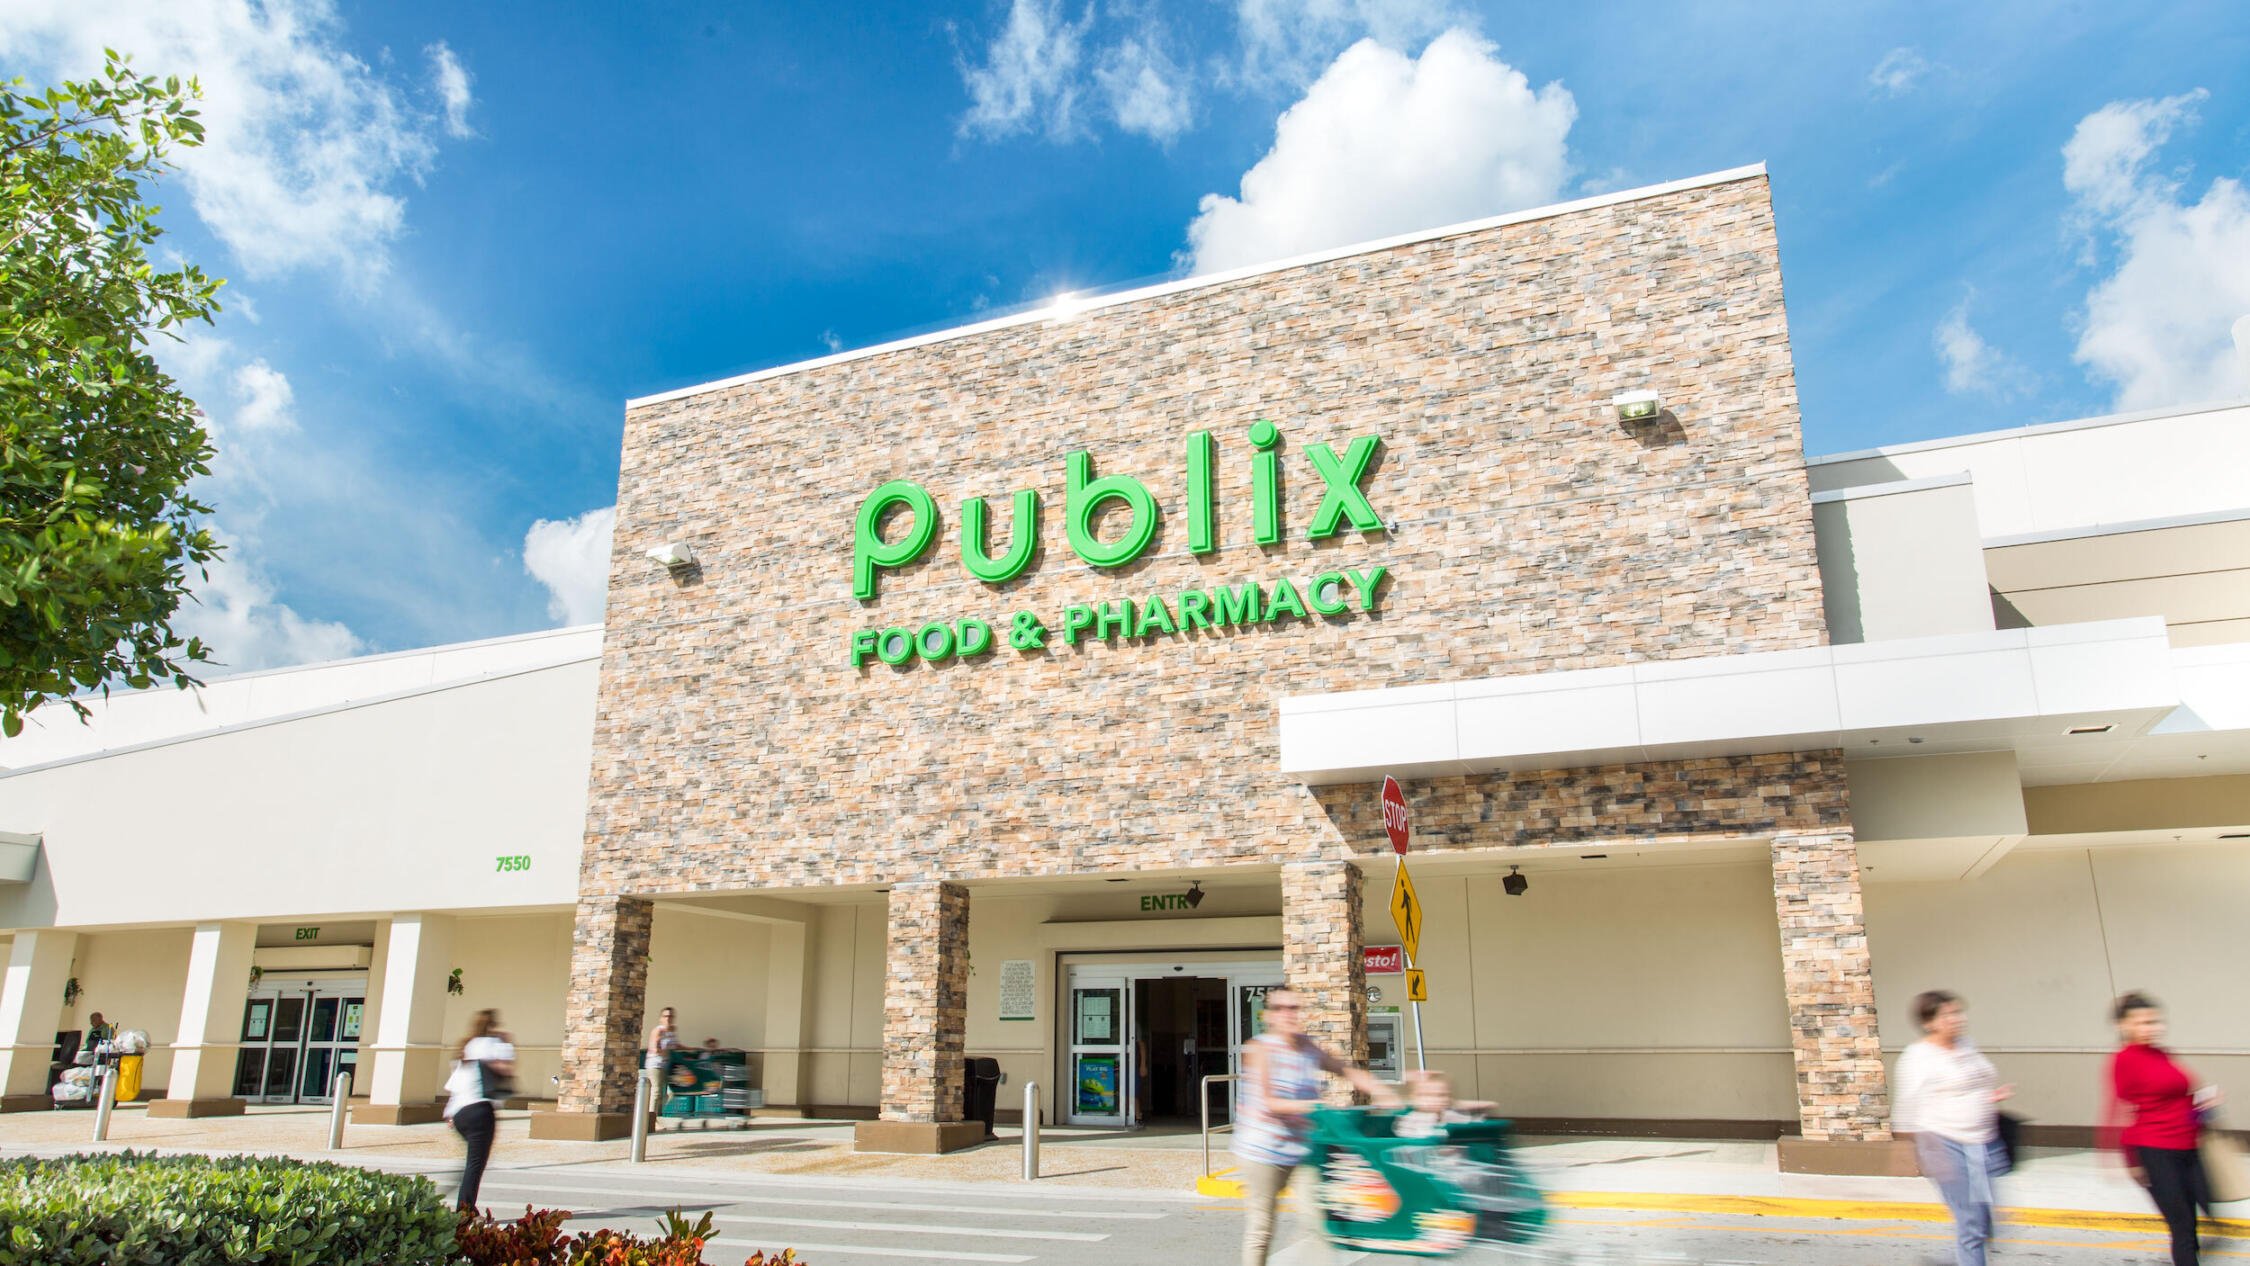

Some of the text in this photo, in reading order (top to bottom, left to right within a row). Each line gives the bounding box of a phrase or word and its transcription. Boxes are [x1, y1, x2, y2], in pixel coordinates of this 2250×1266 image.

[850, 566, 1387, 668] FOOD & PHARMACY
[1385, 799, 1407, 833] STOP
[496, 855, 531, 872] 7550
[1140, 894, 1198, 911] ENTR
[295, 926, 320, 940] EXIT
[1364, 952, 1397, 967] sto!
